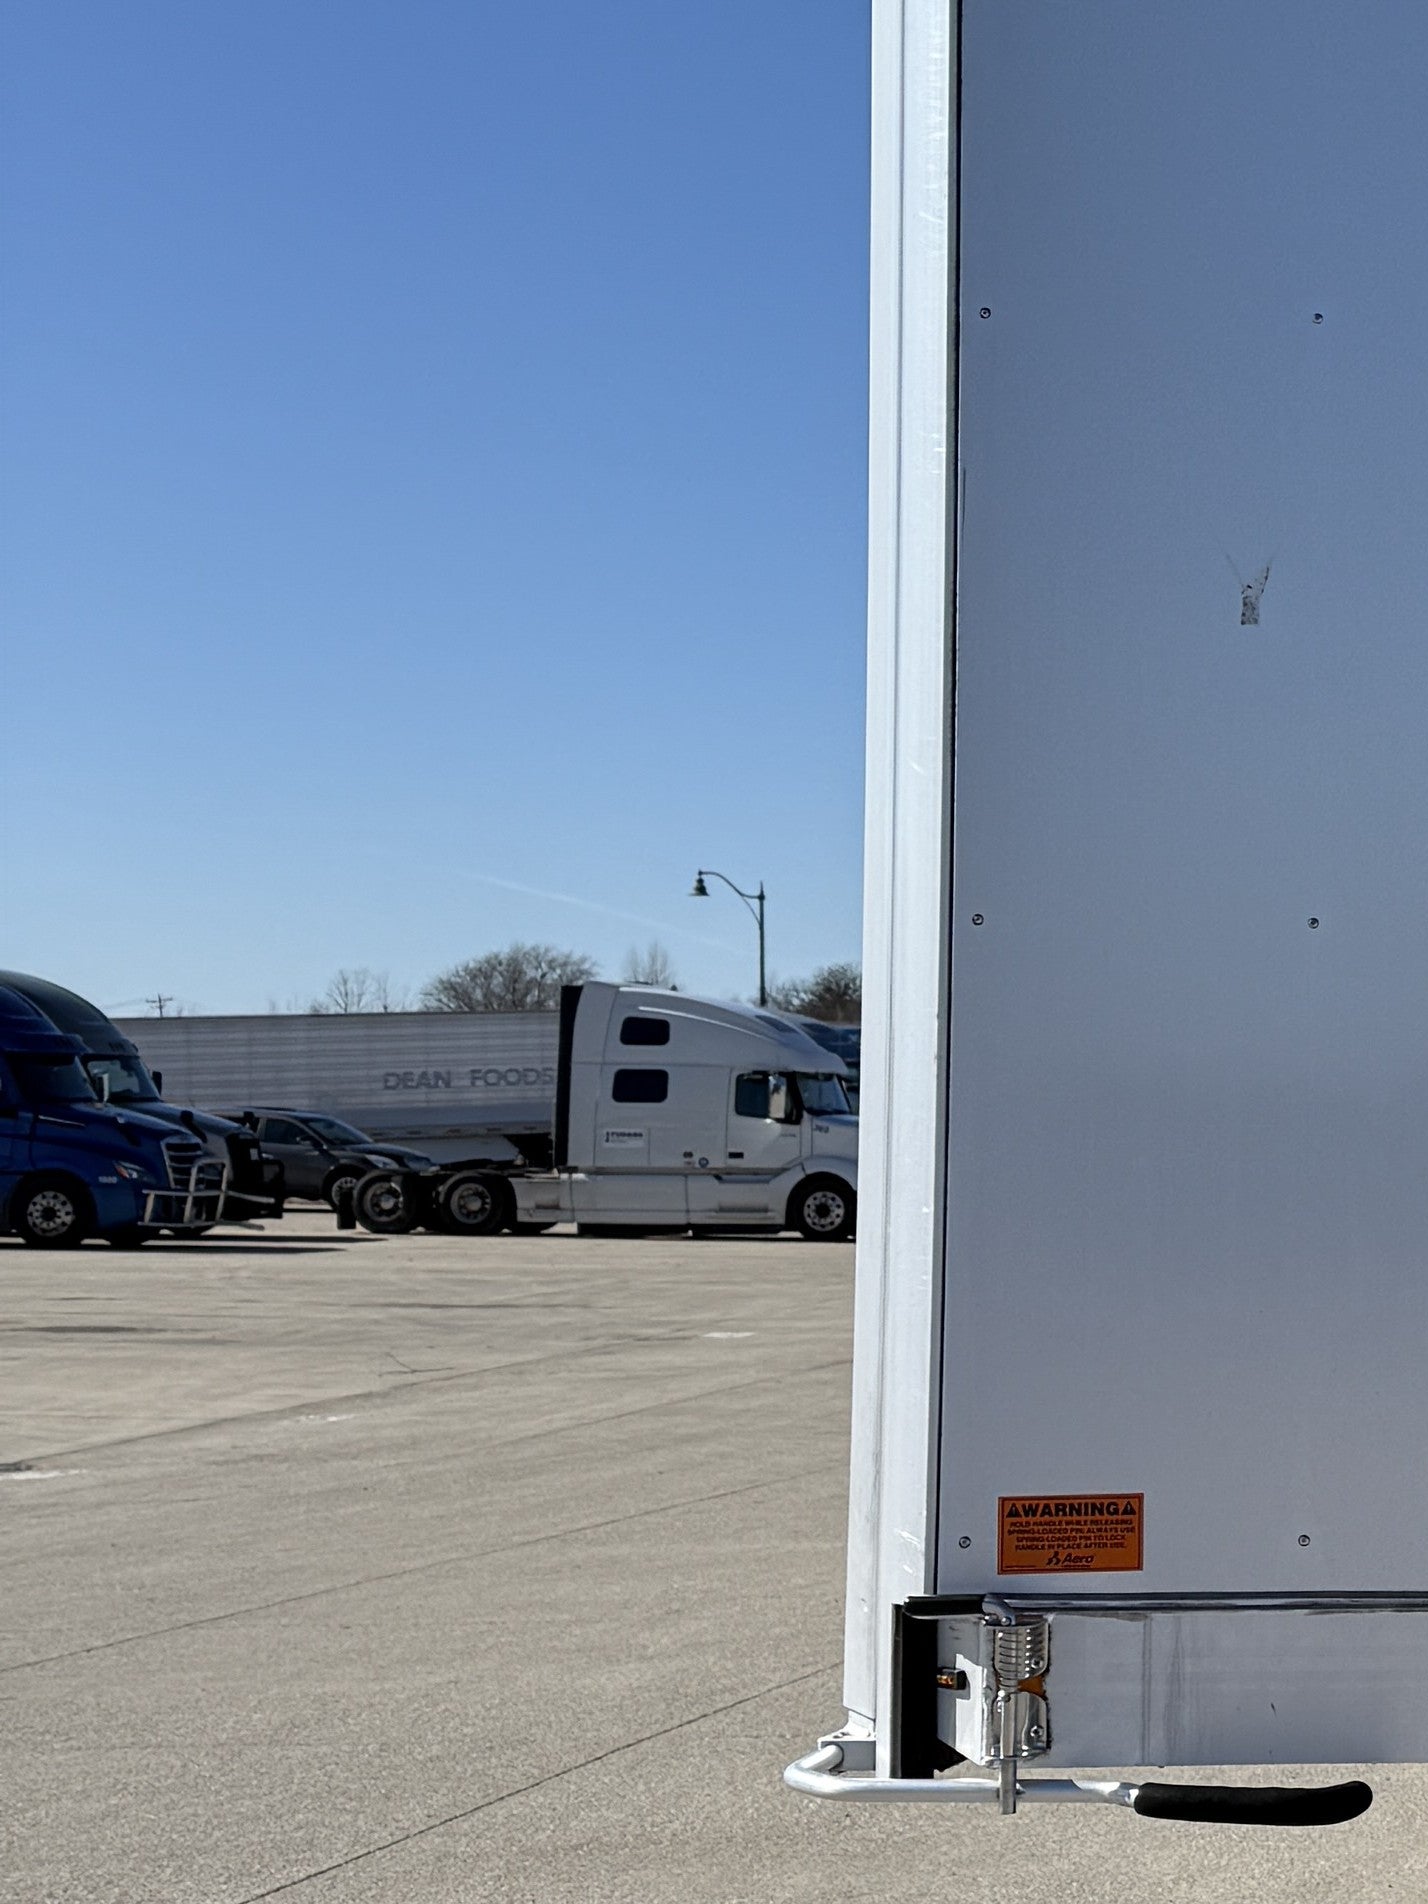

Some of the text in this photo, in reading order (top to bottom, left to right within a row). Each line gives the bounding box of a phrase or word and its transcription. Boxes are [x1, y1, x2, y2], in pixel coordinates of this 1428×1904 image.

[383, 1067, 555, 1090] DEAN FOODS
[1022, 1502, 1120, 1517] WARNING
[1062, 1553, 1094, 1564] Aero
